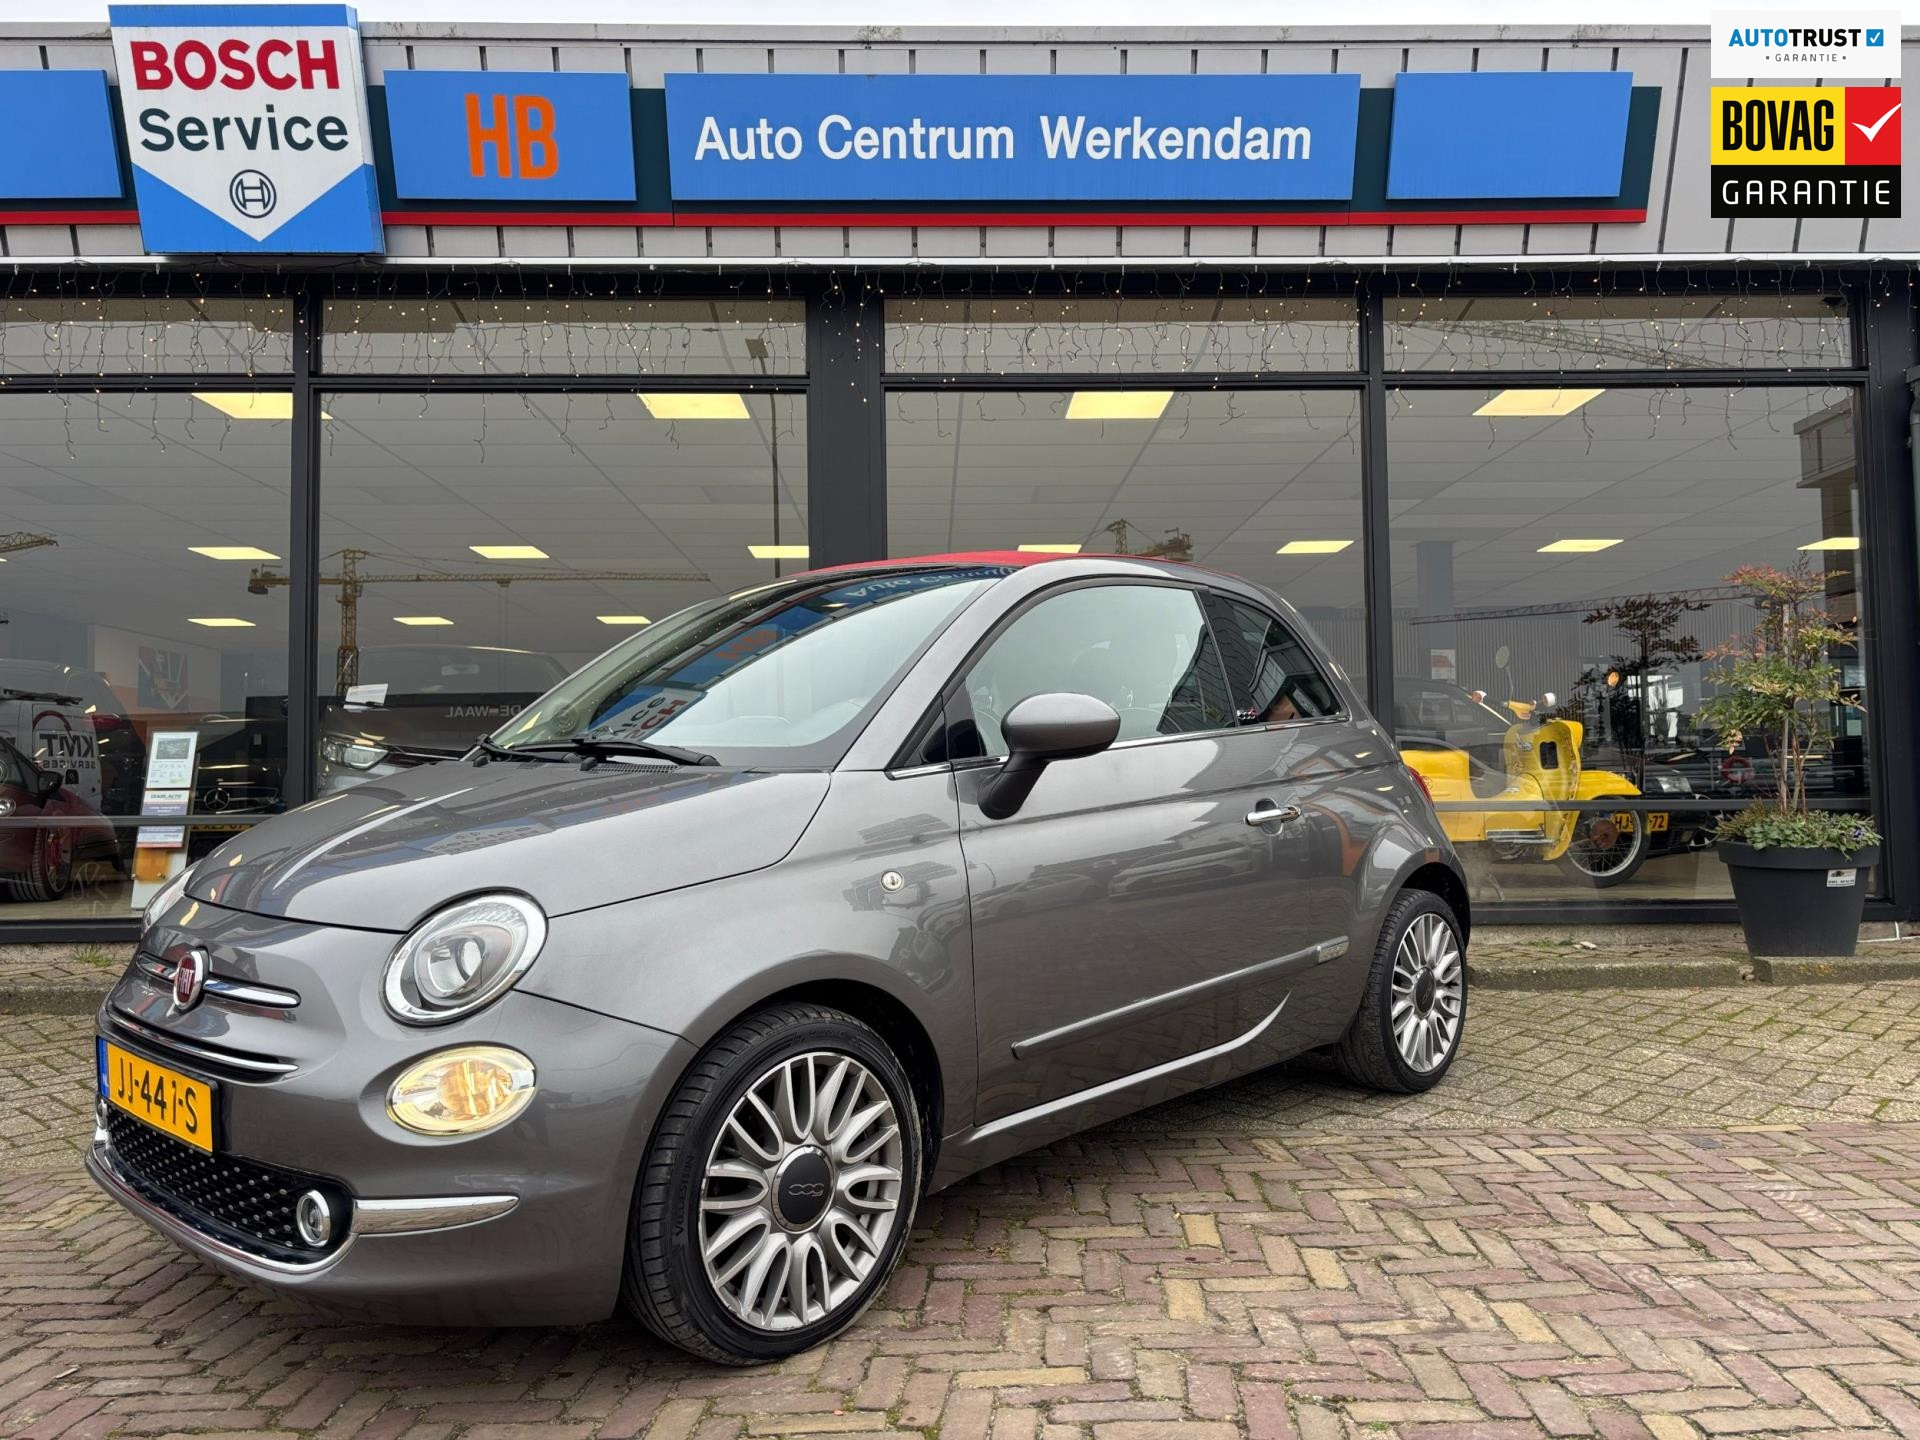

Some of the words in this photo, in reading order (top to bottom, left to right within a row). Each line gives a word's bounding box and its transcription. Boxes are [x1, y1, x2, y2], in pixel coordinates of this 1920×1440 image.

[130, 38, 340, 91] BOSCH
[139, 103, 349, 152] Service
[464, 92, 559, 179] HB
[694, 116, 803, 161] Auto
[818, 114, 1014, 160] Centrum
[1040, 115, 1311, 160] Werkendam
[118, 1057, 198, 1134] JJ-441-S
